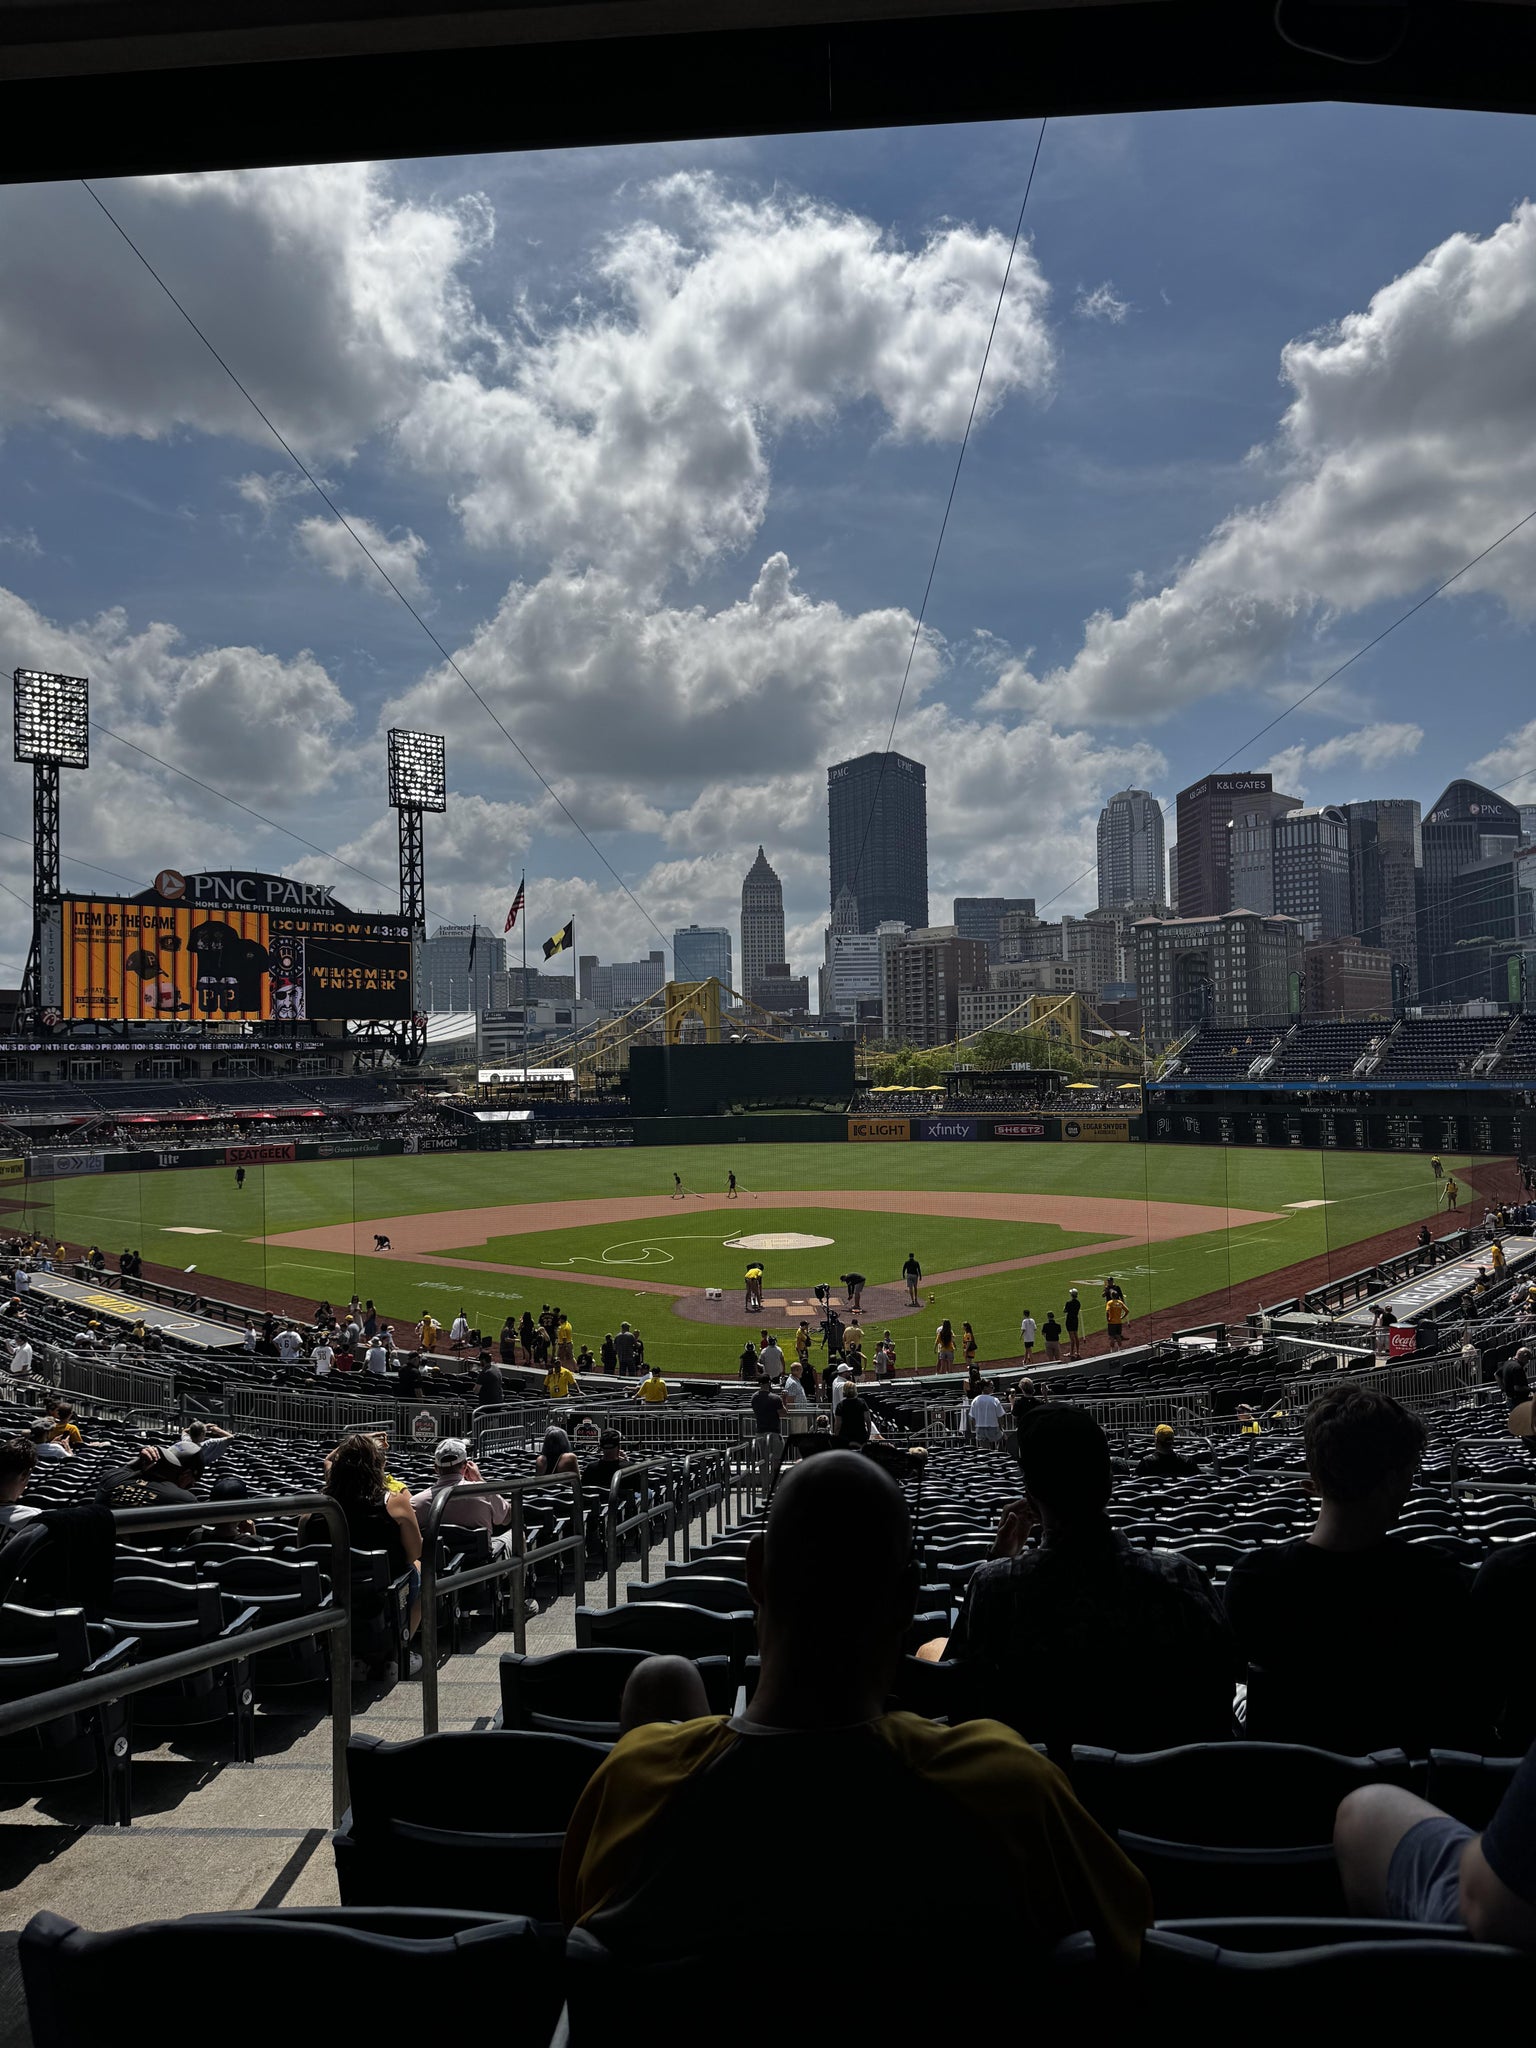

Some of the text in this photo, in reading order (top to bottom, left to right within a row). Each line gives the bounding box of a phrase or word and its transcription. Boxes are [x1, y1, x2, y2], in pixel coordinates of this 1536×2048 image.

[1217, 781, 1266, 790] K&L GATES
[1437, 808, 1450, 820] PNC
[1481, 804, 1502, 815] PNC
[193, 875, 336, 907] PNC PARK
[195, 900, 219, 909] HOME
[235, 903, 250, 911] THE
[253, 904, 301, 914] PITTSBURGH
[304, 908, 335, 916] PIRATES
[75, 912, 175, 930] ITEM OF THE GAME
[273, 920, 409, 937] COUNTDOWN 43:26
[308, 967, 408, 980] WELCOME TO
[320, 979, 396, 990] PNC PARK
[18, 1043, 41, 1051] DROP
[42, 1043, 52, 1051] IN
[52, 1043, 68, 1051] THE
[68, 1043, 101, 1051] CASINO
[101, 1043, 154, 1051] PROMOTIONS
[1011, 1062, 1031, 1071] TIME
[869, 1124, 905, 1136] LIGHT
[928, 1122, 970, 1137] xfinity
[997, 1126, 1041, 1134] SHEETZ
[420, 1139, 458, 1151] BETMGM
[159, 1153, 180, 1167] Lite
[229, 1146, 291, 1163] SEATGEEK
[85, 1156, 102, 1169] 125
[1384, 1274, 1471, 1306] WELCOME
[284, 1340, 290, 1349] 6
